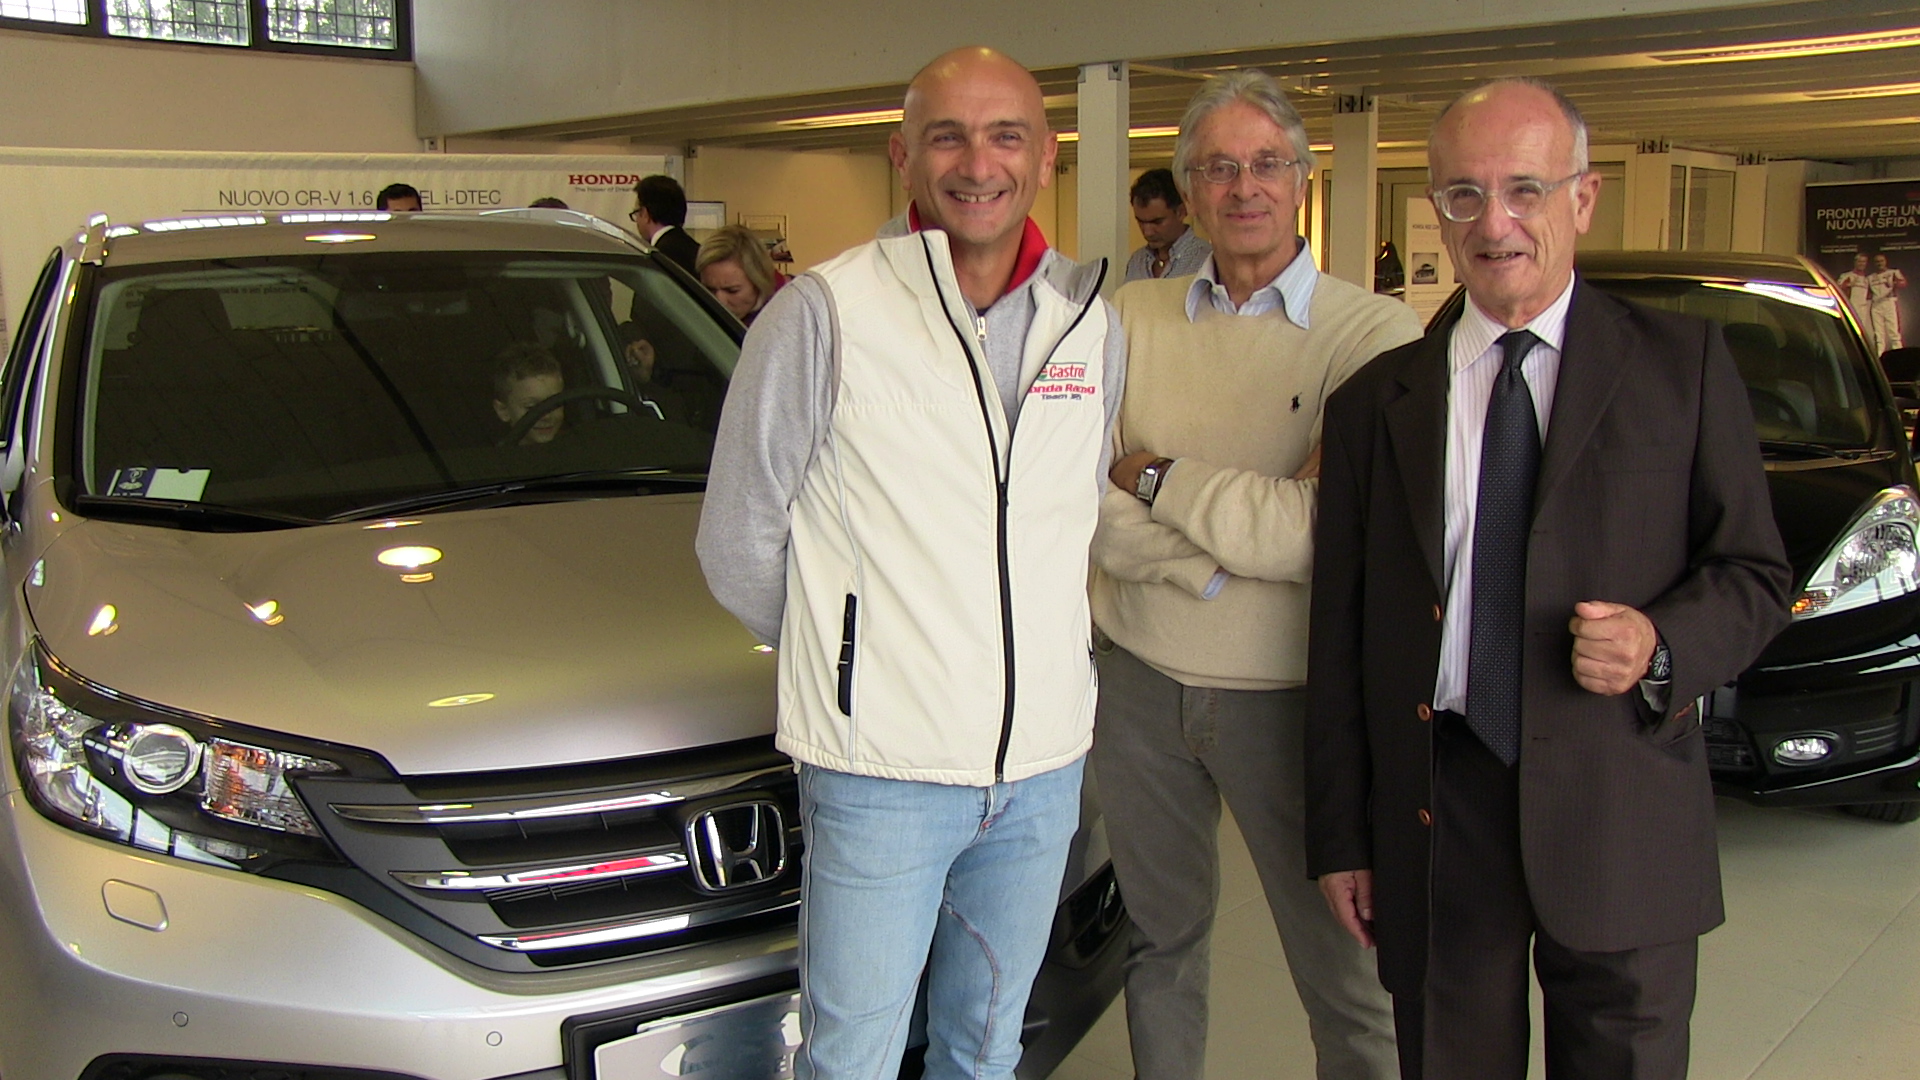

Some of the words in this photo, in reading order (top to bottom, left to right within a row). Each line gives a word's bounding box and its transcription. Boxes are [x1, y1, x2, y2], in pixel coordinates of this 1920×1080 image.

[568, 174, 642, 185] HONDA
[219, 190, 290, 206] NUOVO
[295, 190, 341, 206] CR-V
[348, 190, 374, 206] 1.6
[445, 190, 501, 205] i-DTEC
[1817, 207, 1867, 220] PRONTI
[1870, 206, 1898, 218] PER
[1826, 219, 1874, 231] NUOVA
[1876, 216, 1919, 229] SFIDA.
[1049, 364, 1086, 378] Castro
[1029, 384, 1062, 393] onda
